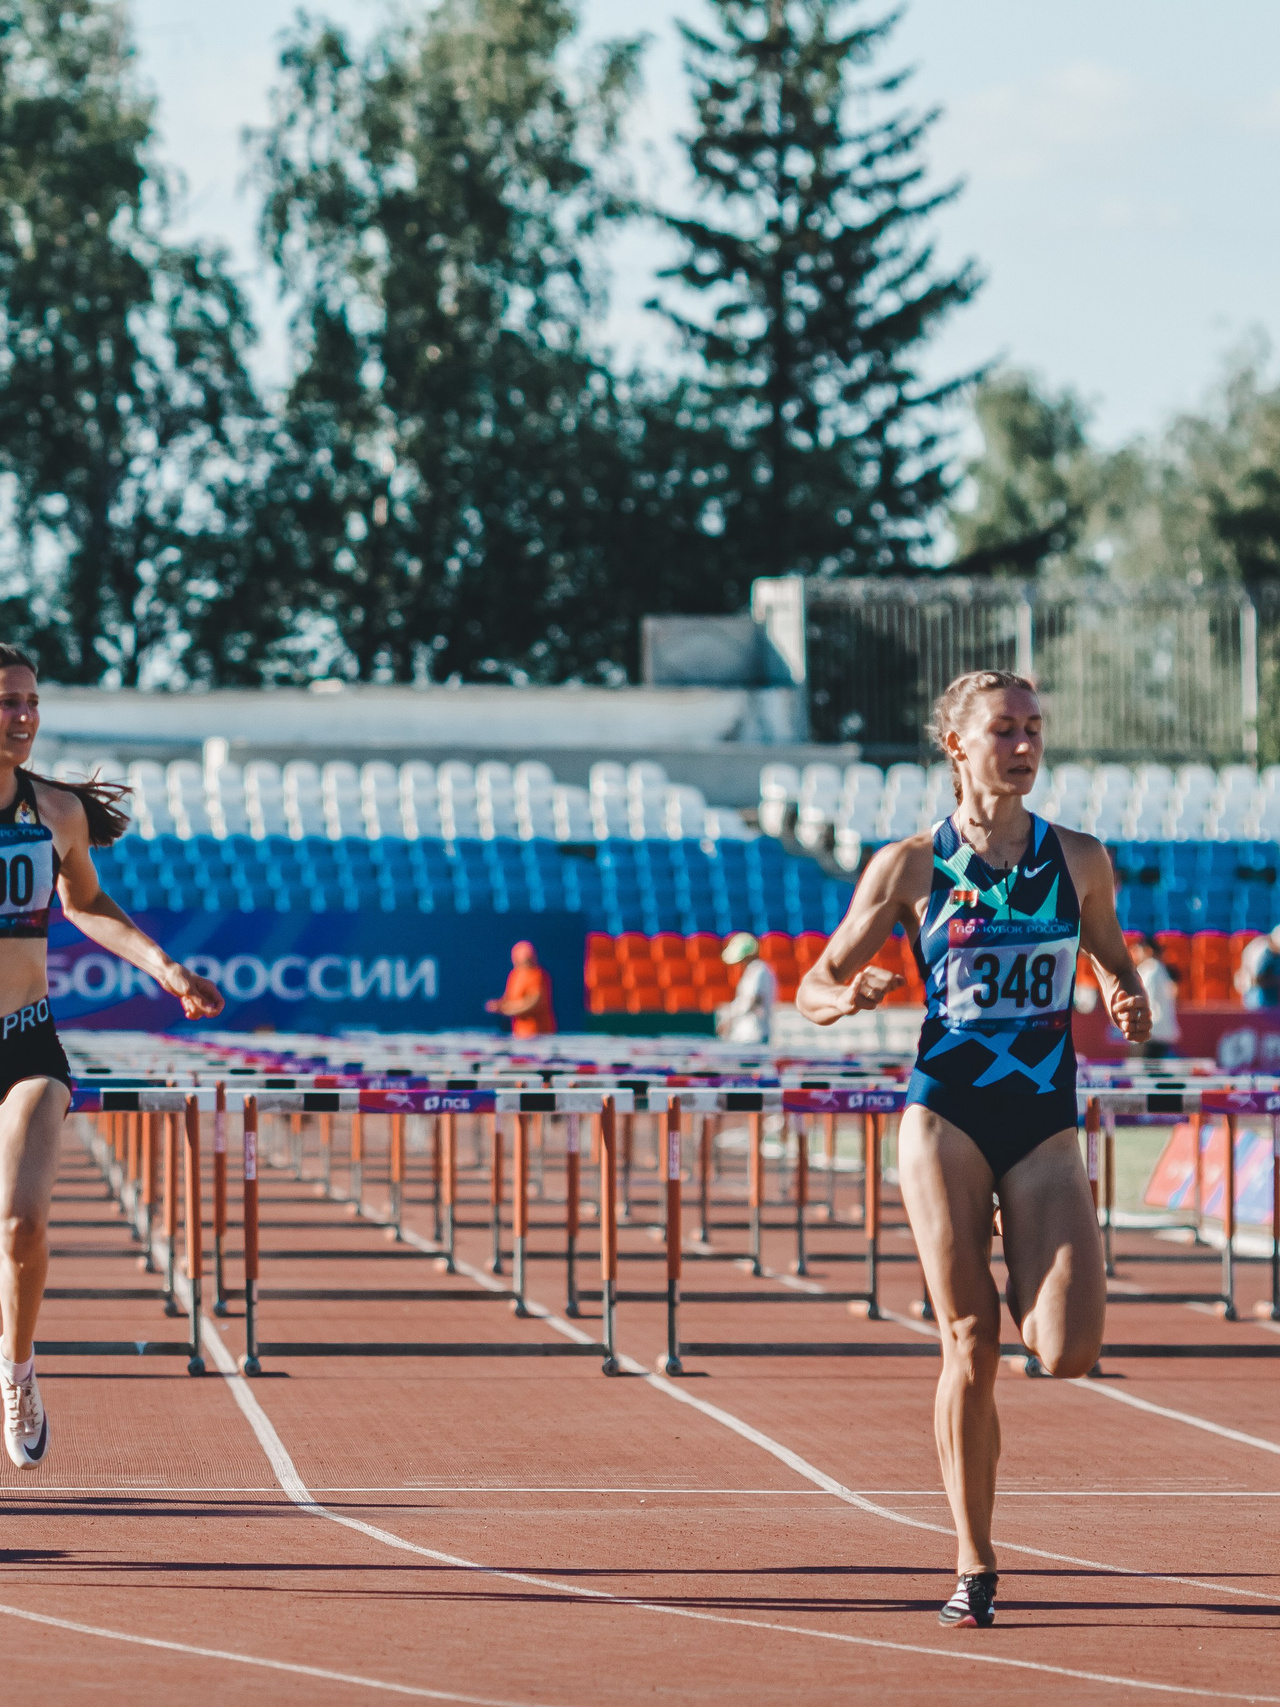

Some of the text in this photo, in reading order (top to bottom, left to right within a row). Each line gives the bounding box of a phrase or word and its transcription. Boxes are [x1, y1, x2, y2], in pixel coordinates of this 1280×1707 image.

[983, 925, 1023, 934] КУБОК
[973, 953, 1057, 1008] 348
[3, 998, 50, 1040] PRO
[442, 1097, 470, 1109] ПСБ
